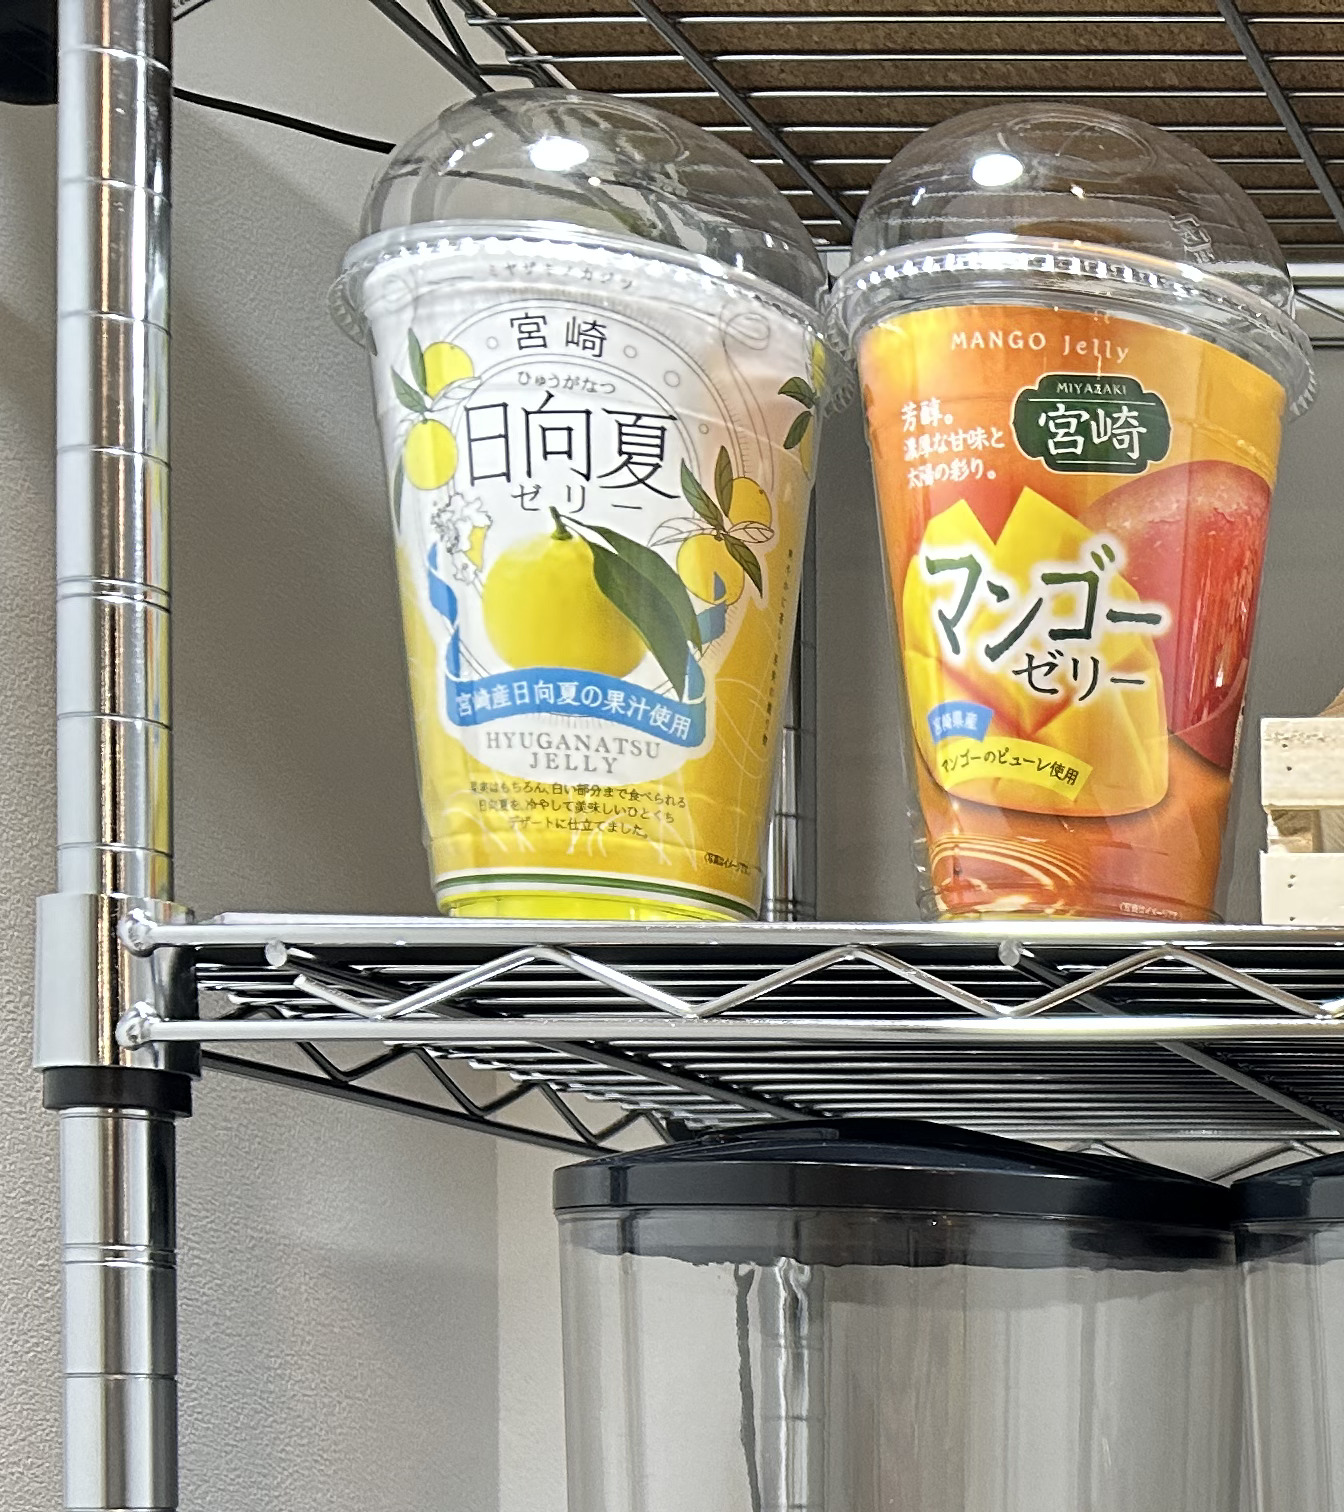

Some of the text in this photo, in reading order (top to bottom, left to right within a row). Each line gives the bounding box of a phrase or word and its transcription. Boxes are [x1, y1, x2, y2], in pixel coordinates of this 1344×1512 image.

[510, 312, 609, 358] 宮崎
[951, 331, 1130, 364] MANGO Jelly
[518, 370, 617, 394] ひゅうがなつ
[1056, 382, 1128, 396] MIYAZAKI
[464, 390, 681, 500] 日向夏
[1038, 403, 1148, 460] 宮崎
[512, 484, 643, 514] ゼリー
[924, 543, 1163, 662] マンゴー
[1012, 649, 1146, 702] ゼリー
[455, 680, 693, 742] 宮崎産日向夏の果汁使用
[486, 731, 661, 760] HYUGANATSU
[529, 752, 619, 774] JELLY
[941, 746, 1080, 787] マンゴーのピューレ使用
